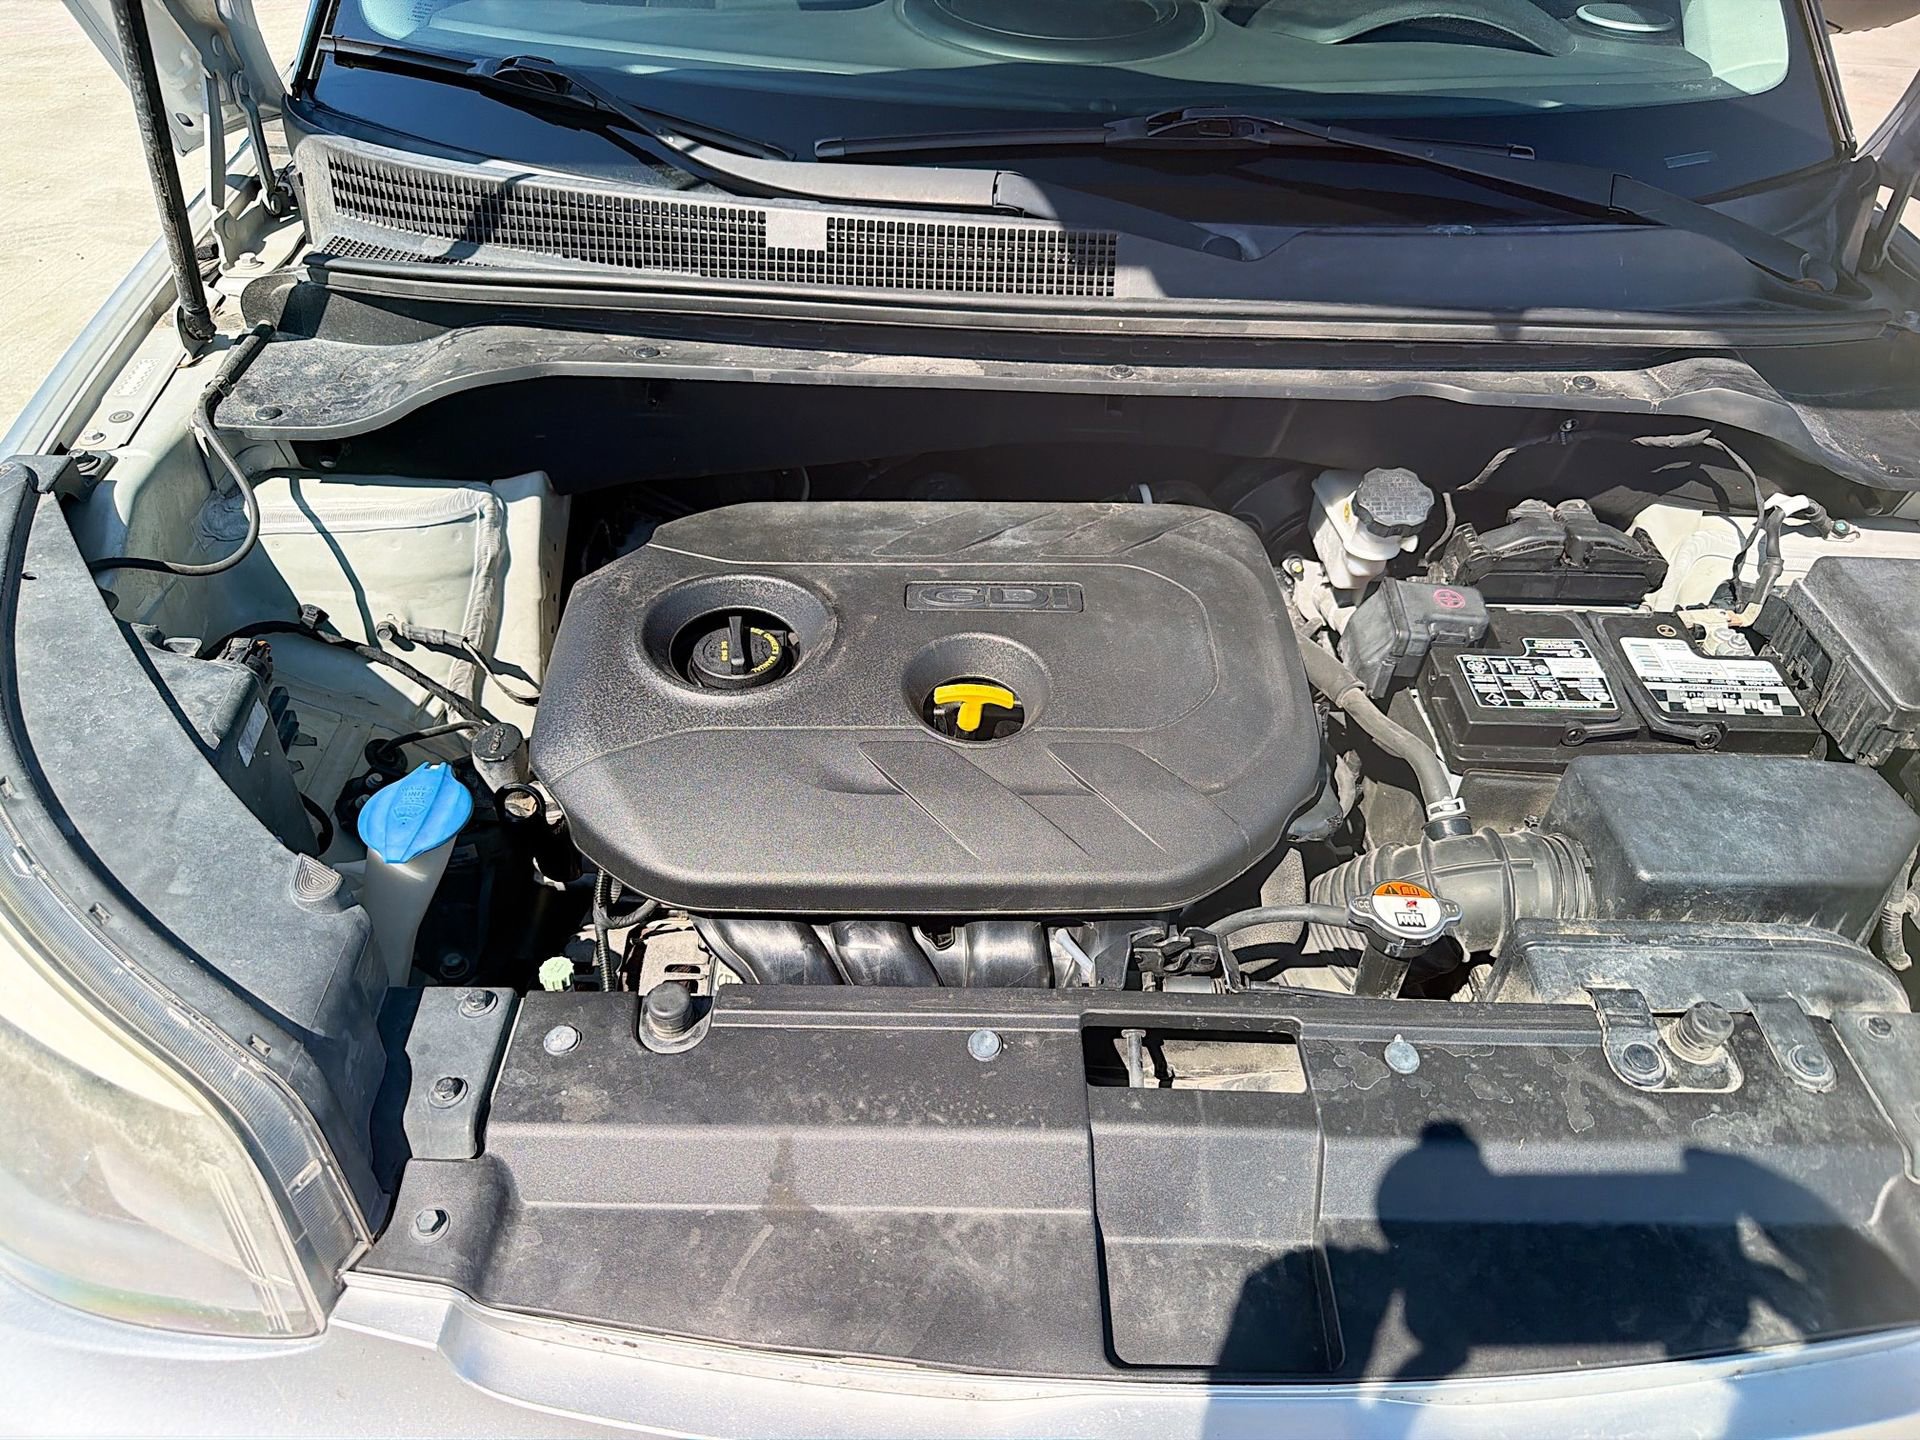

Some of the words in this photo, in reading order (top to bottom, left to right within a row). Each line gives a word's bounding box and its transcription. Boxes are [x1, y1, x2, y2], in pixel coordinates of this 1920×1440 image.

[918, 586, 1069, 608] GDI
[1679, 690, 1736, 699] PLATINUM
[1682, 697, 1781, 714] Duralast
